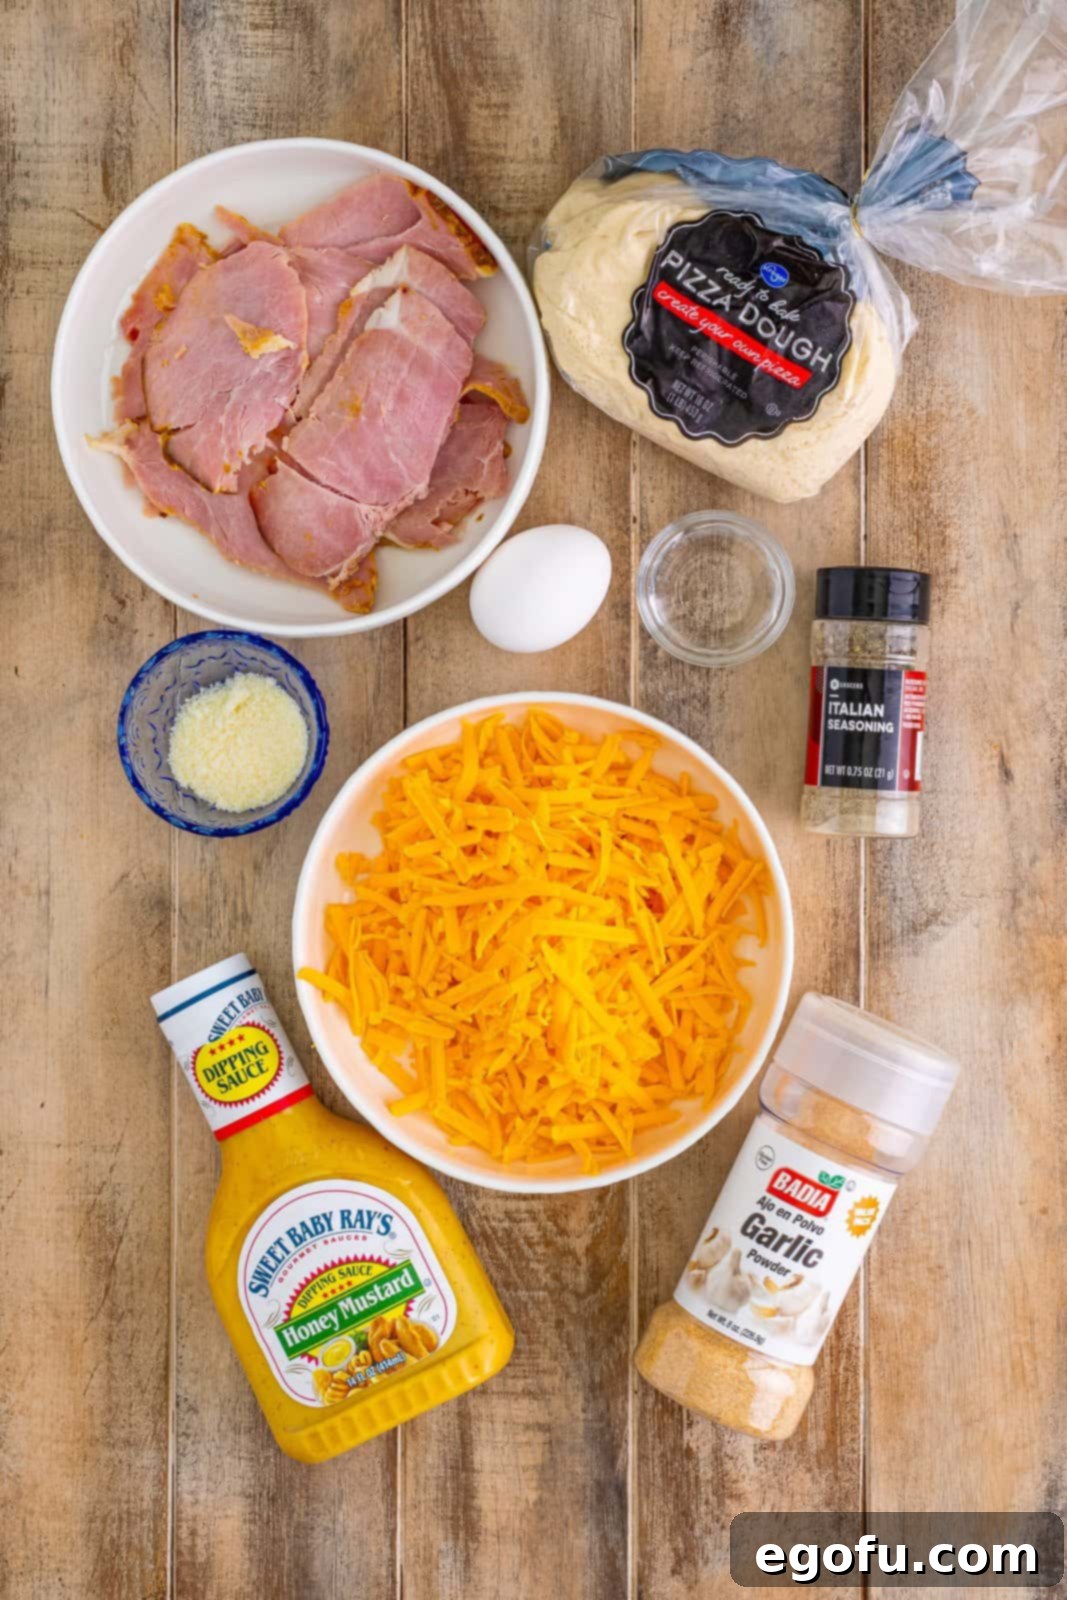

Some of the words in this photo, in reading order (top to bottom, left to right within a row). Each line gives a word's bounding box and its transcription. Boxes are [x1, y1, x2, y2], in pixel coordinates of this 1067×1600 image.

[660, 250, 731, 312] PIZZA
[738, 302, 833, 372] DOUGH
[716, 267, 755, 298] ready
[755, 289, 769, 302] to
[768, 300, 800, 322] bake
[657, 290, 699, 320] create
[689, 314, 733, 339] your
[732, 340, 761, 362] own
[754, 358, 801, 386] pizza
[827, 718, 895, 734] SEASONING
[828, 701, 885, 718] ITALIAN
[825, 764, 835, 775] NET
[836, 765, 846, 776] WT
[846, 766, 862, 777] 0.75
[863, 767, 874, 778] OZ
[208, 1001, 240, 1043] SWEET
[202, 1040, 269, 1083] DIPPING
[216, 1059, 268, 1094] SAUCE
[771, 1171, 833, 1212] BADIA
[756, 1195, 774, 1214] Ajo
[775, 1207, 791, 1221] en
[792, 1211, 825, 1236] Polvo
[248, 1237, 292, 1299] SWEET
[286, 1211, 334, 1248] BABY
[339, 1209, 394, 1236] RAY'S
[278, 1244, 318, 1284] GOURMET
[323, 1234, 368, 1246] SAUCES
[740, 1212, 824, 1269] Garlic
[746, 1248, 791, 1277] Powder
[281, 1305, 339, 1348] Honey
[337, 1268, 415, 1321] Mustard
[297, 1273, 337, 1310] DIPPING
[338, 1264, 373, 1280] SAUCE
